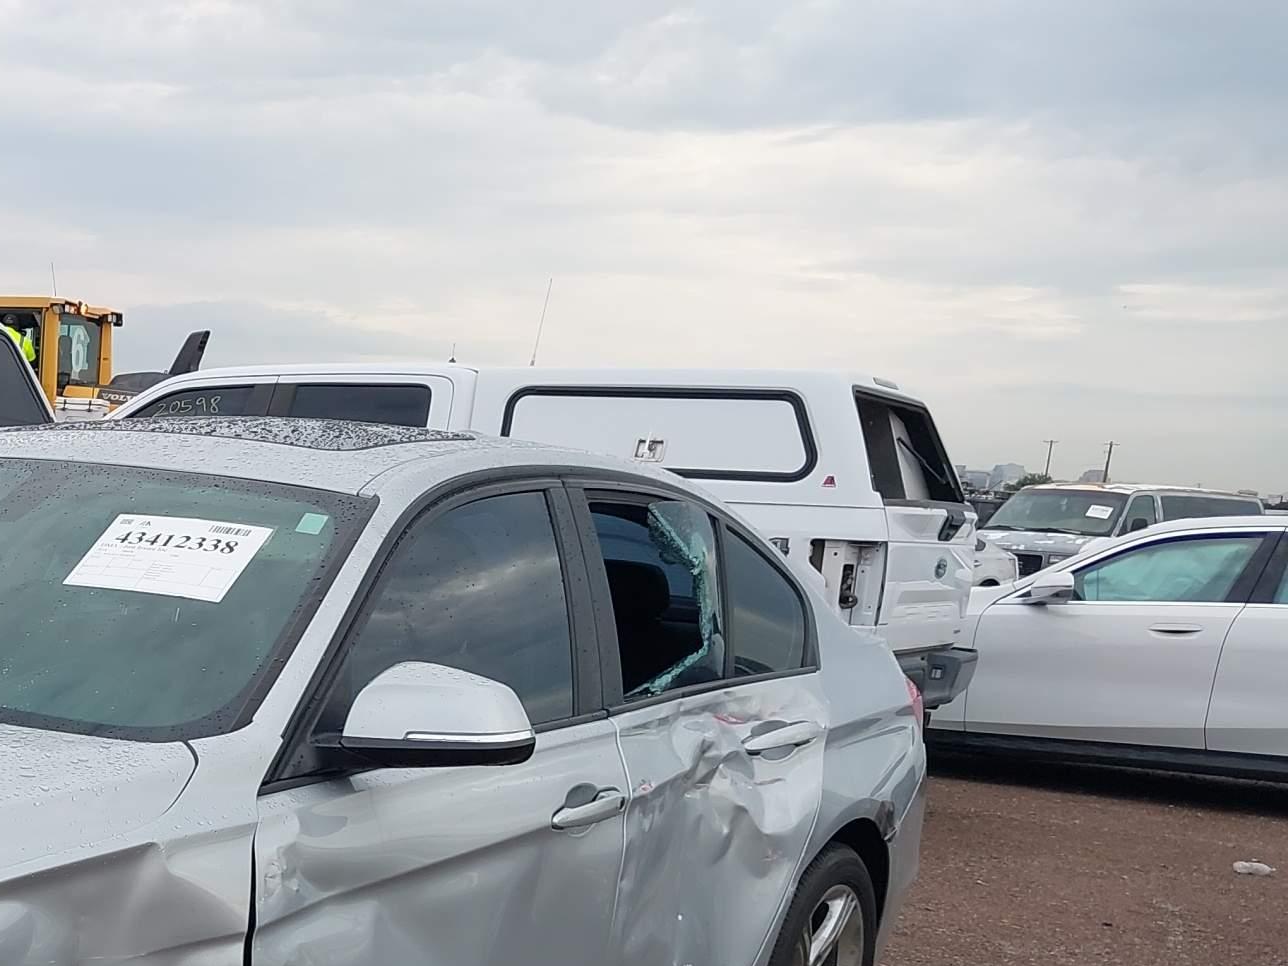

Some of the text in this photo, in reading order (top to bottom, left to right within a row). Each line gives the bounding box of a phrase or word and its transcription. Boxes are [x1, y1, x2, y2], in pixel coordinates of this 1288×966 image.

[101, 392, 136, 402] VOLV
[152, 395, 222, 418] 20598
[115, 530, 239, 555] 43412338
